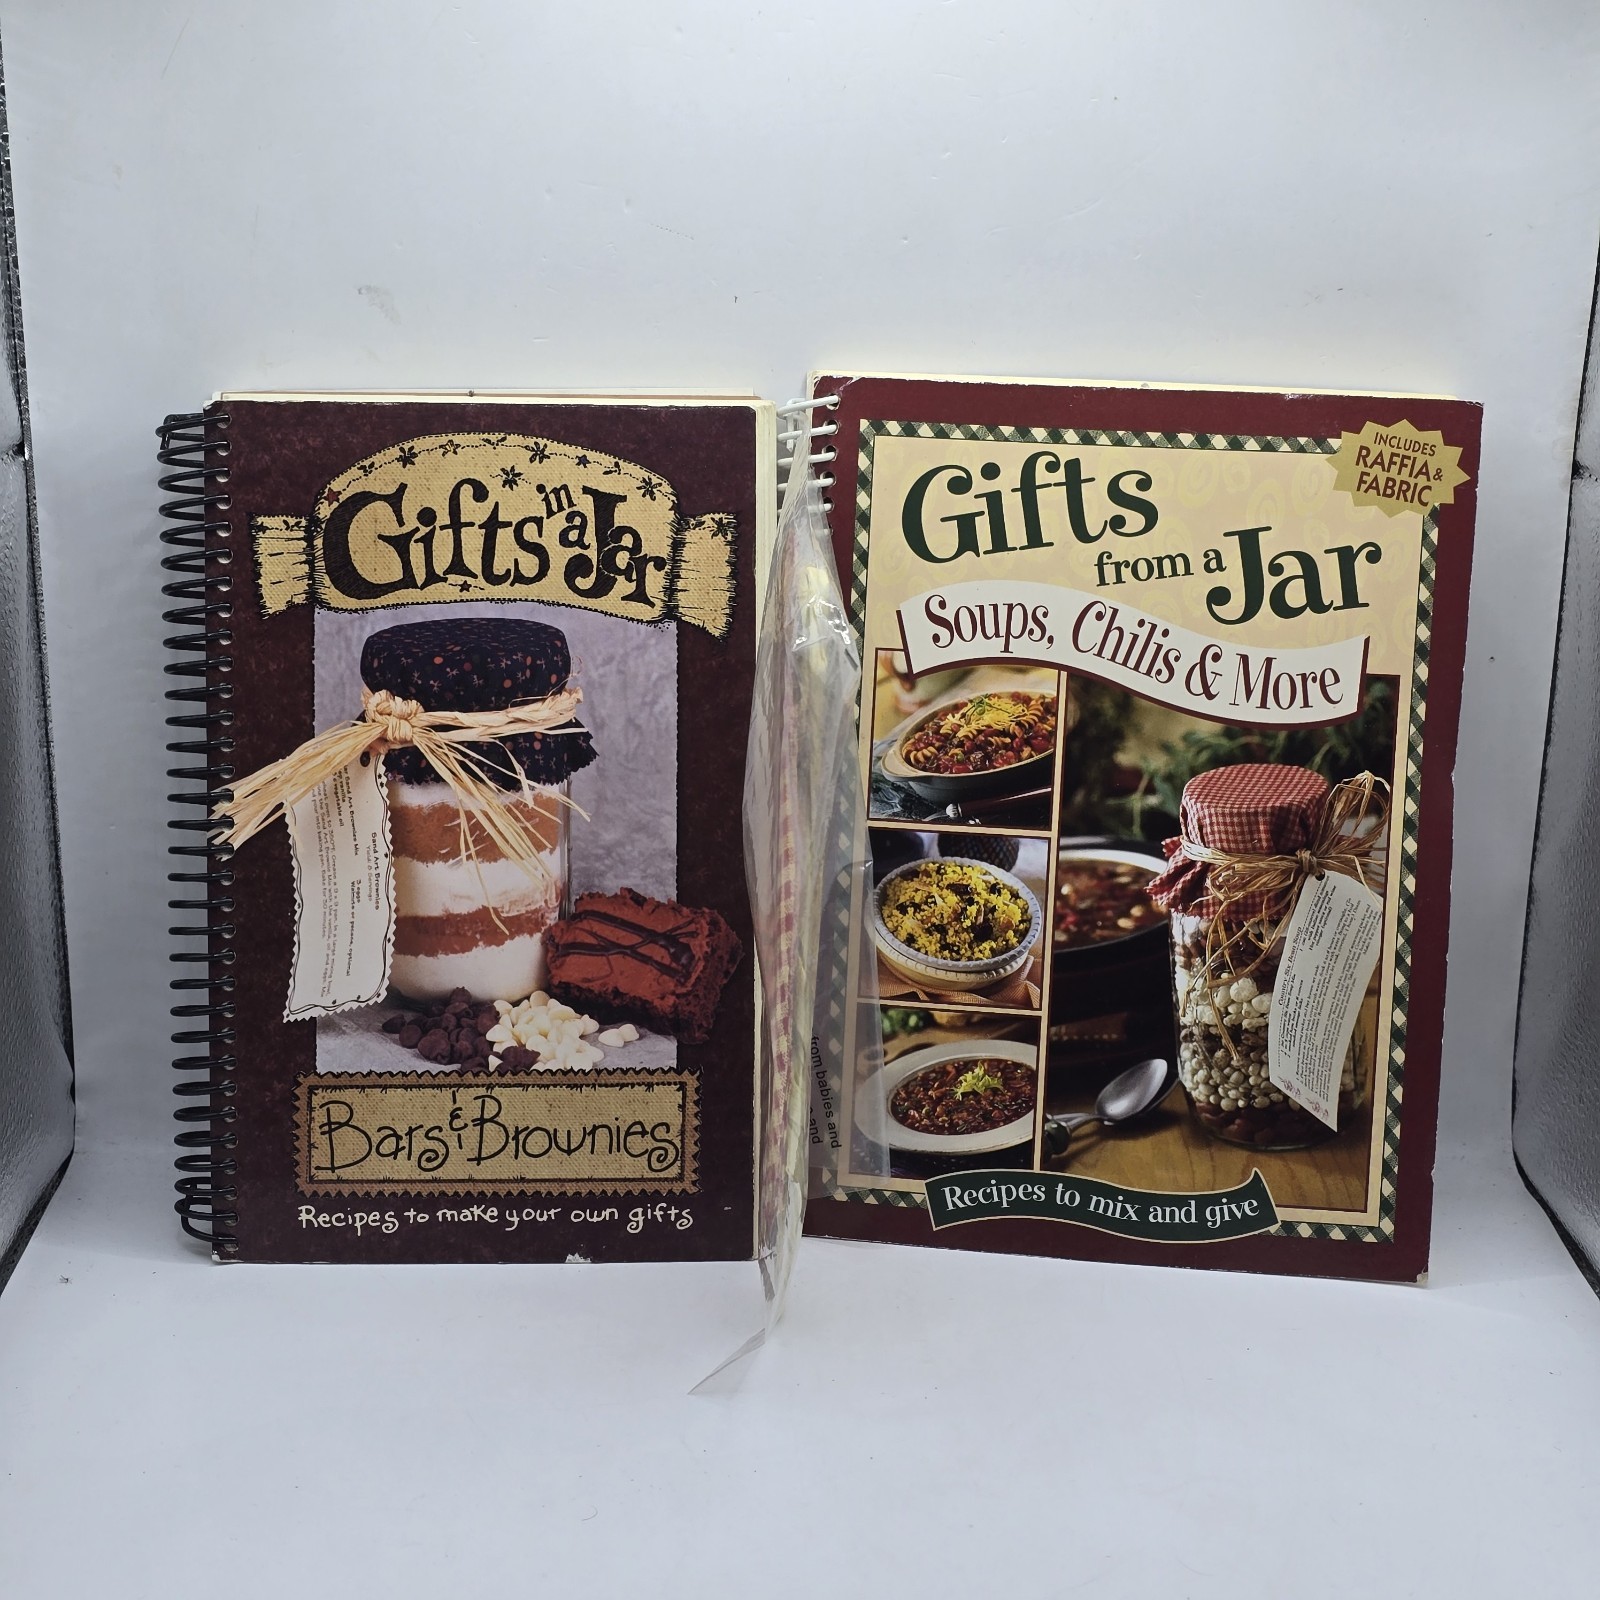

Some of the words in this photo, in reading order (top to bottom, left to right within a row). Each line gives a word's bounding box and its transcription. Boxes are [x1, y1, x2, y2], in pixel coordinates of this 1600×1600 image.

[1355, 445, 1431, 482] RAFFIA
[1432, 467, 1444, 482] &
[1373, 431, 1437, 457] INCLUDES
[536, 482, 576, 521] in
[901, 450, 1160, 564] Gifts
[1356, 471, 1432, 507] FABRIC
[322, 477, 549, 600] Gifts
[559, 511, 591, 550] a
[562, 485, 667, 608] Jar
[1094, 550, 1194, 588] from
[1203, 548, 1227, 573] a
[1205, 525, 1383, 625] Jar
[924, 594, 1055, 654] Soups,
[1071, 599, 1182, 684] Chilis
[1184, 643, 1224, 700] &
[1229, 652, 1343, 711] More
[810, 1036, 824, 1069] from
[816, 1069, 834, 1118] babies
[315, 1099, 449, 1172] Bars
[448, 1090, 468, 1150] &
[467, 1094, 680, 1172] Brownies
[827, 1121, 842, 1149] and
[298, 1204, 399, 1236] Recipes
[404, 1208, 429, 1224] to
[436, 1204, 499, 1223] make
[505, 1207, 561, 1231] your
[570, 1207, 619, 1224] own
[626, 1203, 694, 1234] gifts
[941, 1179, 1046, 1211] Recipes
[1054, 1182, 1080, 1207] to
[1087, 1193, 1142, 1222] mix
[1148, 1200, 1198, 1223] and
[1205, 1198, 1259, 1229] give
